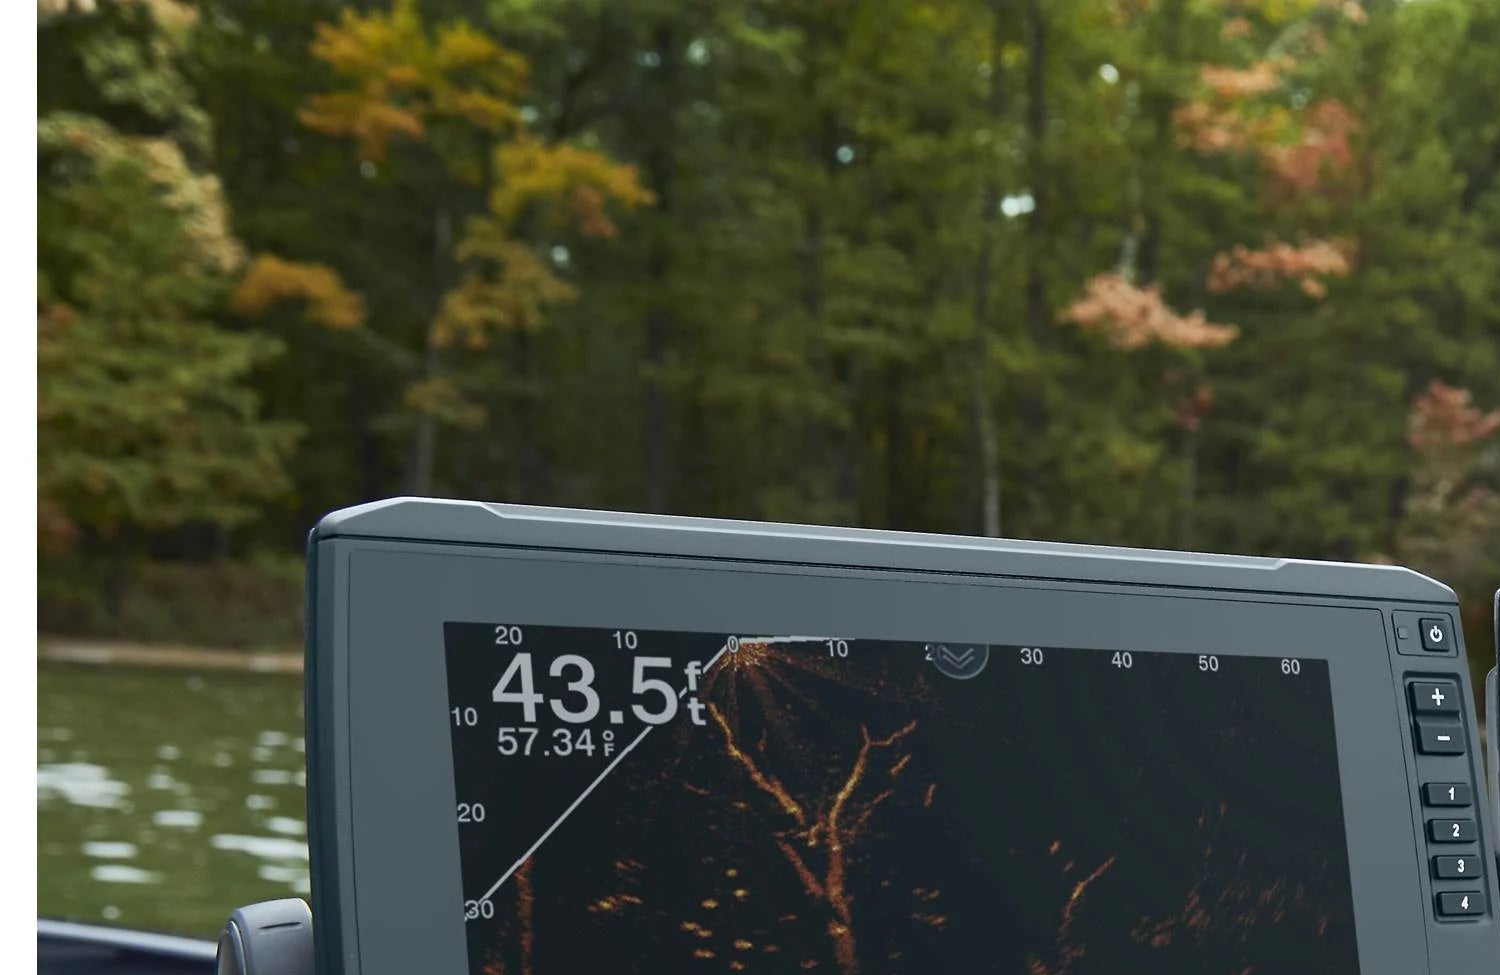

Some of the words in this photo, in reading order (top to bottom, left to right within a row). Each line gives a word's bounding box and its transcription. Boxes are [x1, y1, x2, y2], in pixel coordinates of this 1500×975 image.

[495, 626, 522, 645] 20
[612, 631, 637, 649] 10
[728, 636, 739, 653] 0
[826, 640, 848, 657] 10
[1020, 648, 1043, 664] 30
[1111, 651, 1132, 669] 40
[1199, 656, 1220, 674] 50
[1281, 658, 1300, 675] 60
[492, 652, 678, 725] 43.5
[451, 707, 478, 726] 10
[498, 727, 596, 757] 57.34
[1448, 787, 1455, 800] 1
[456, 804, 486, 823] 20
[1452, 824, 1460, 838] 2
[1458, 859, 1464, 872] 3
[465, 900, 494, 919] 30
[1461, 896, 1469, 910] 4
